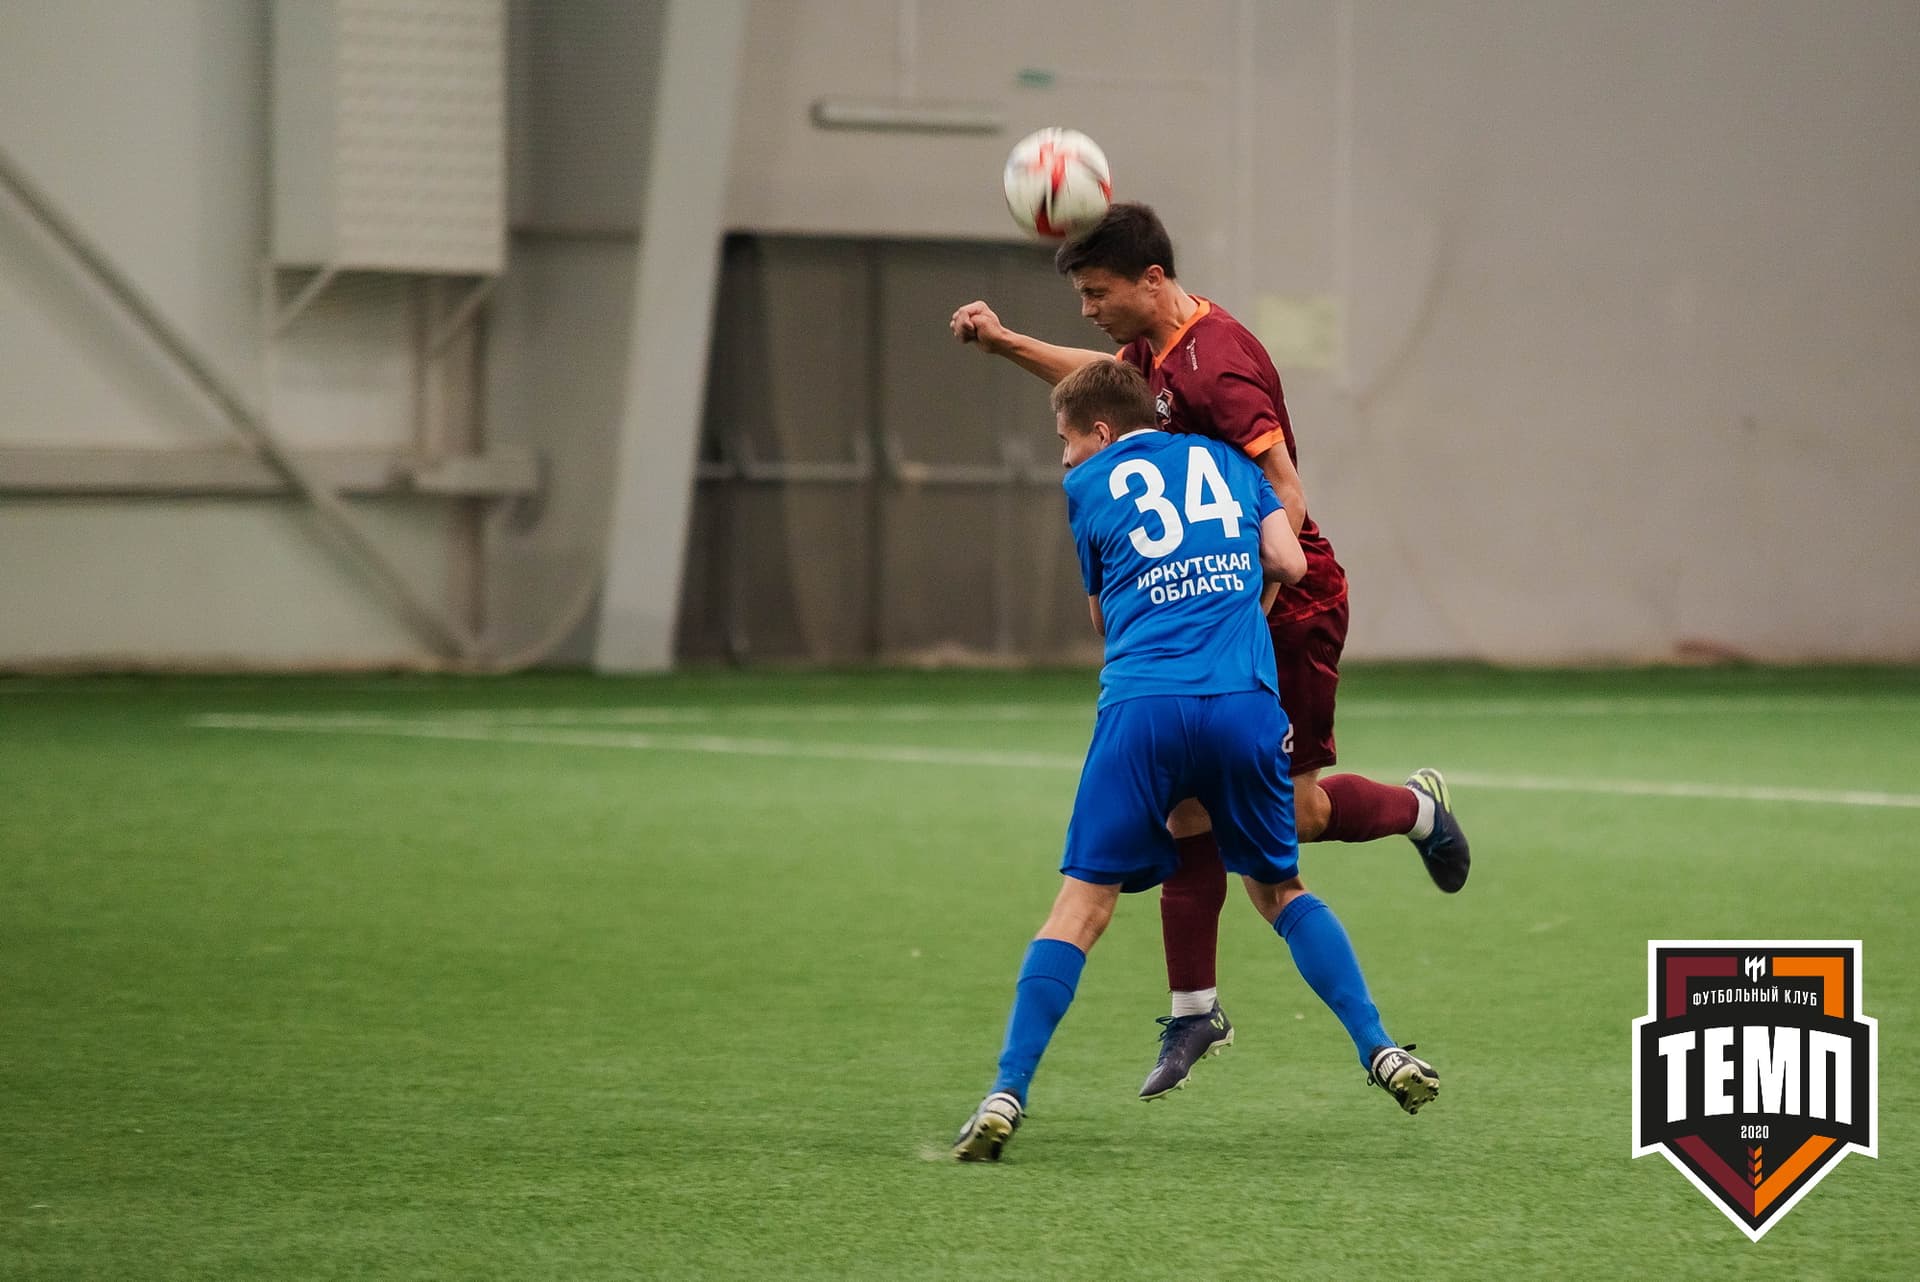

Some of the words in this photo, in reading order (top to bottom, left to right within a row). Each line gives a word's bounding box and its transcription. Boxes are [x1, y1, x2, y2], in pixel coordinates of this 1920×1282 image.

[1109, 446, 1243, 558] 34
[1136, 553, 1251, 590] ИРКУТСКАЯ
[1150, 573, 1245, 605] ОБЛАСТЬ
[1378, 1053, 1403, 1082] NIKE
